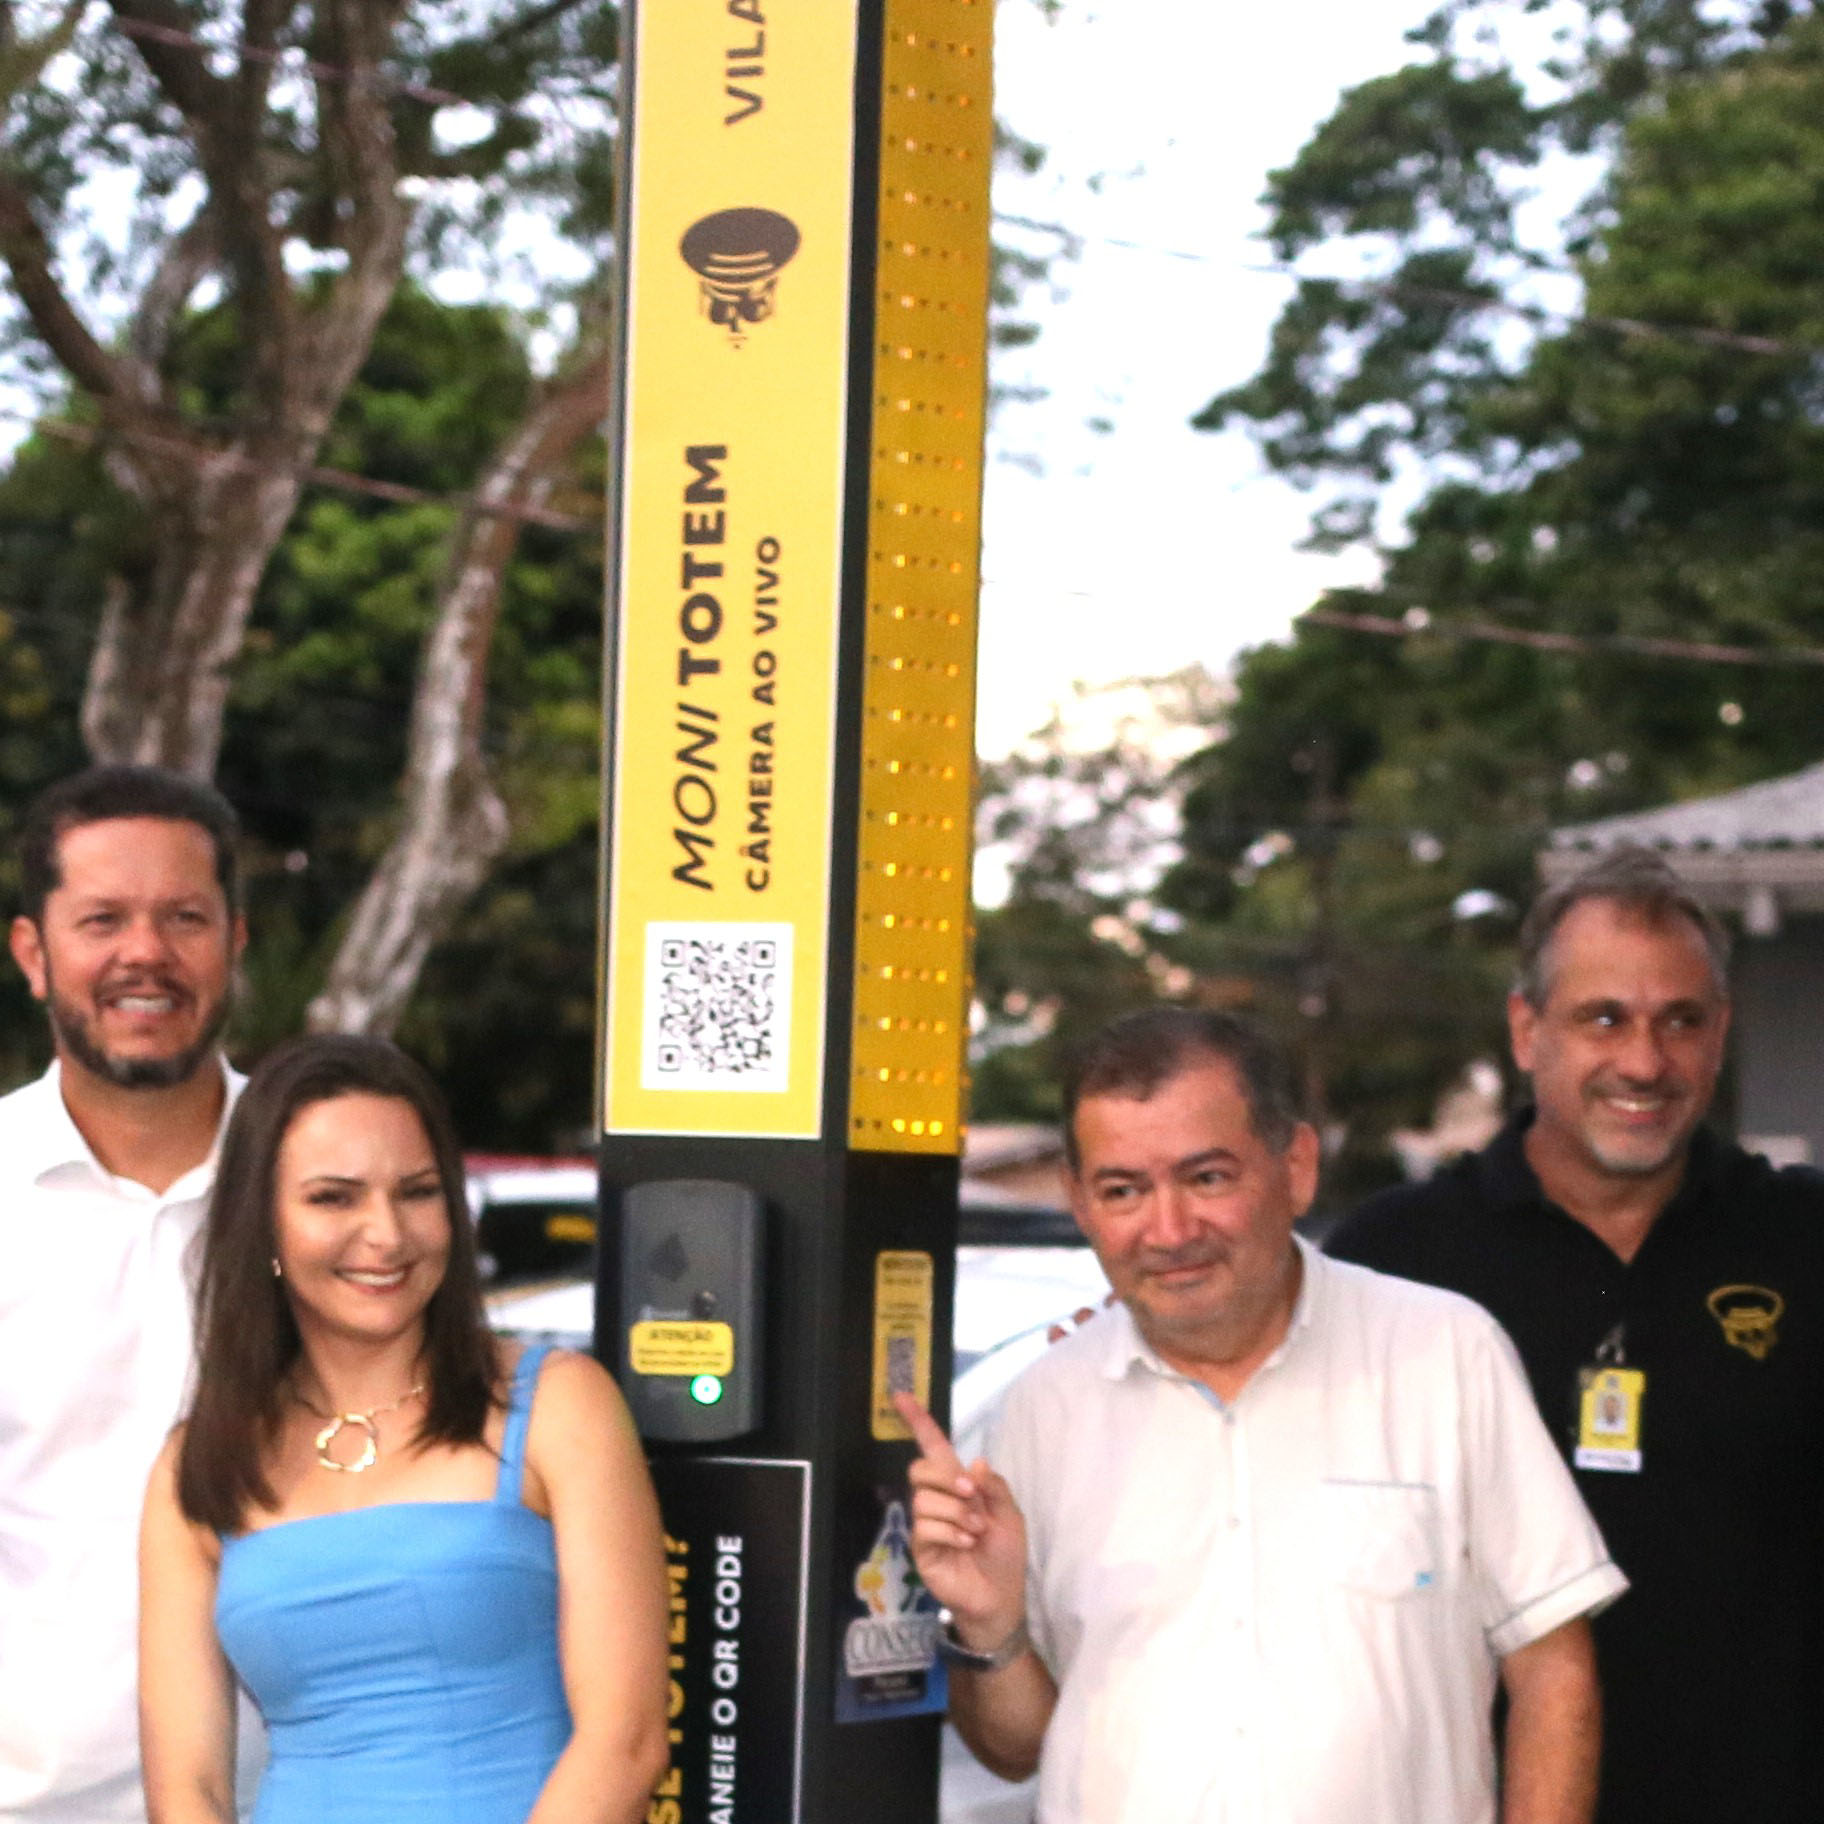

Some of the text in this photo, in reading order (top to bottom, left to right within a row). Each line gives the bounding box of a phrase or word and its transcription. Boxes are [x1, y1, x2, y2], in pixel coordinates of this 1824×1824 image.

[670, 443, 729, 892] MONI TOTEM
[738, 536, 782, 893] CÂMERA AO VIVO
[714, 1534, 743, 1631] CODE
[710, 1697, 738, 1726] O
[711, 1639, 740, 1690] QR
